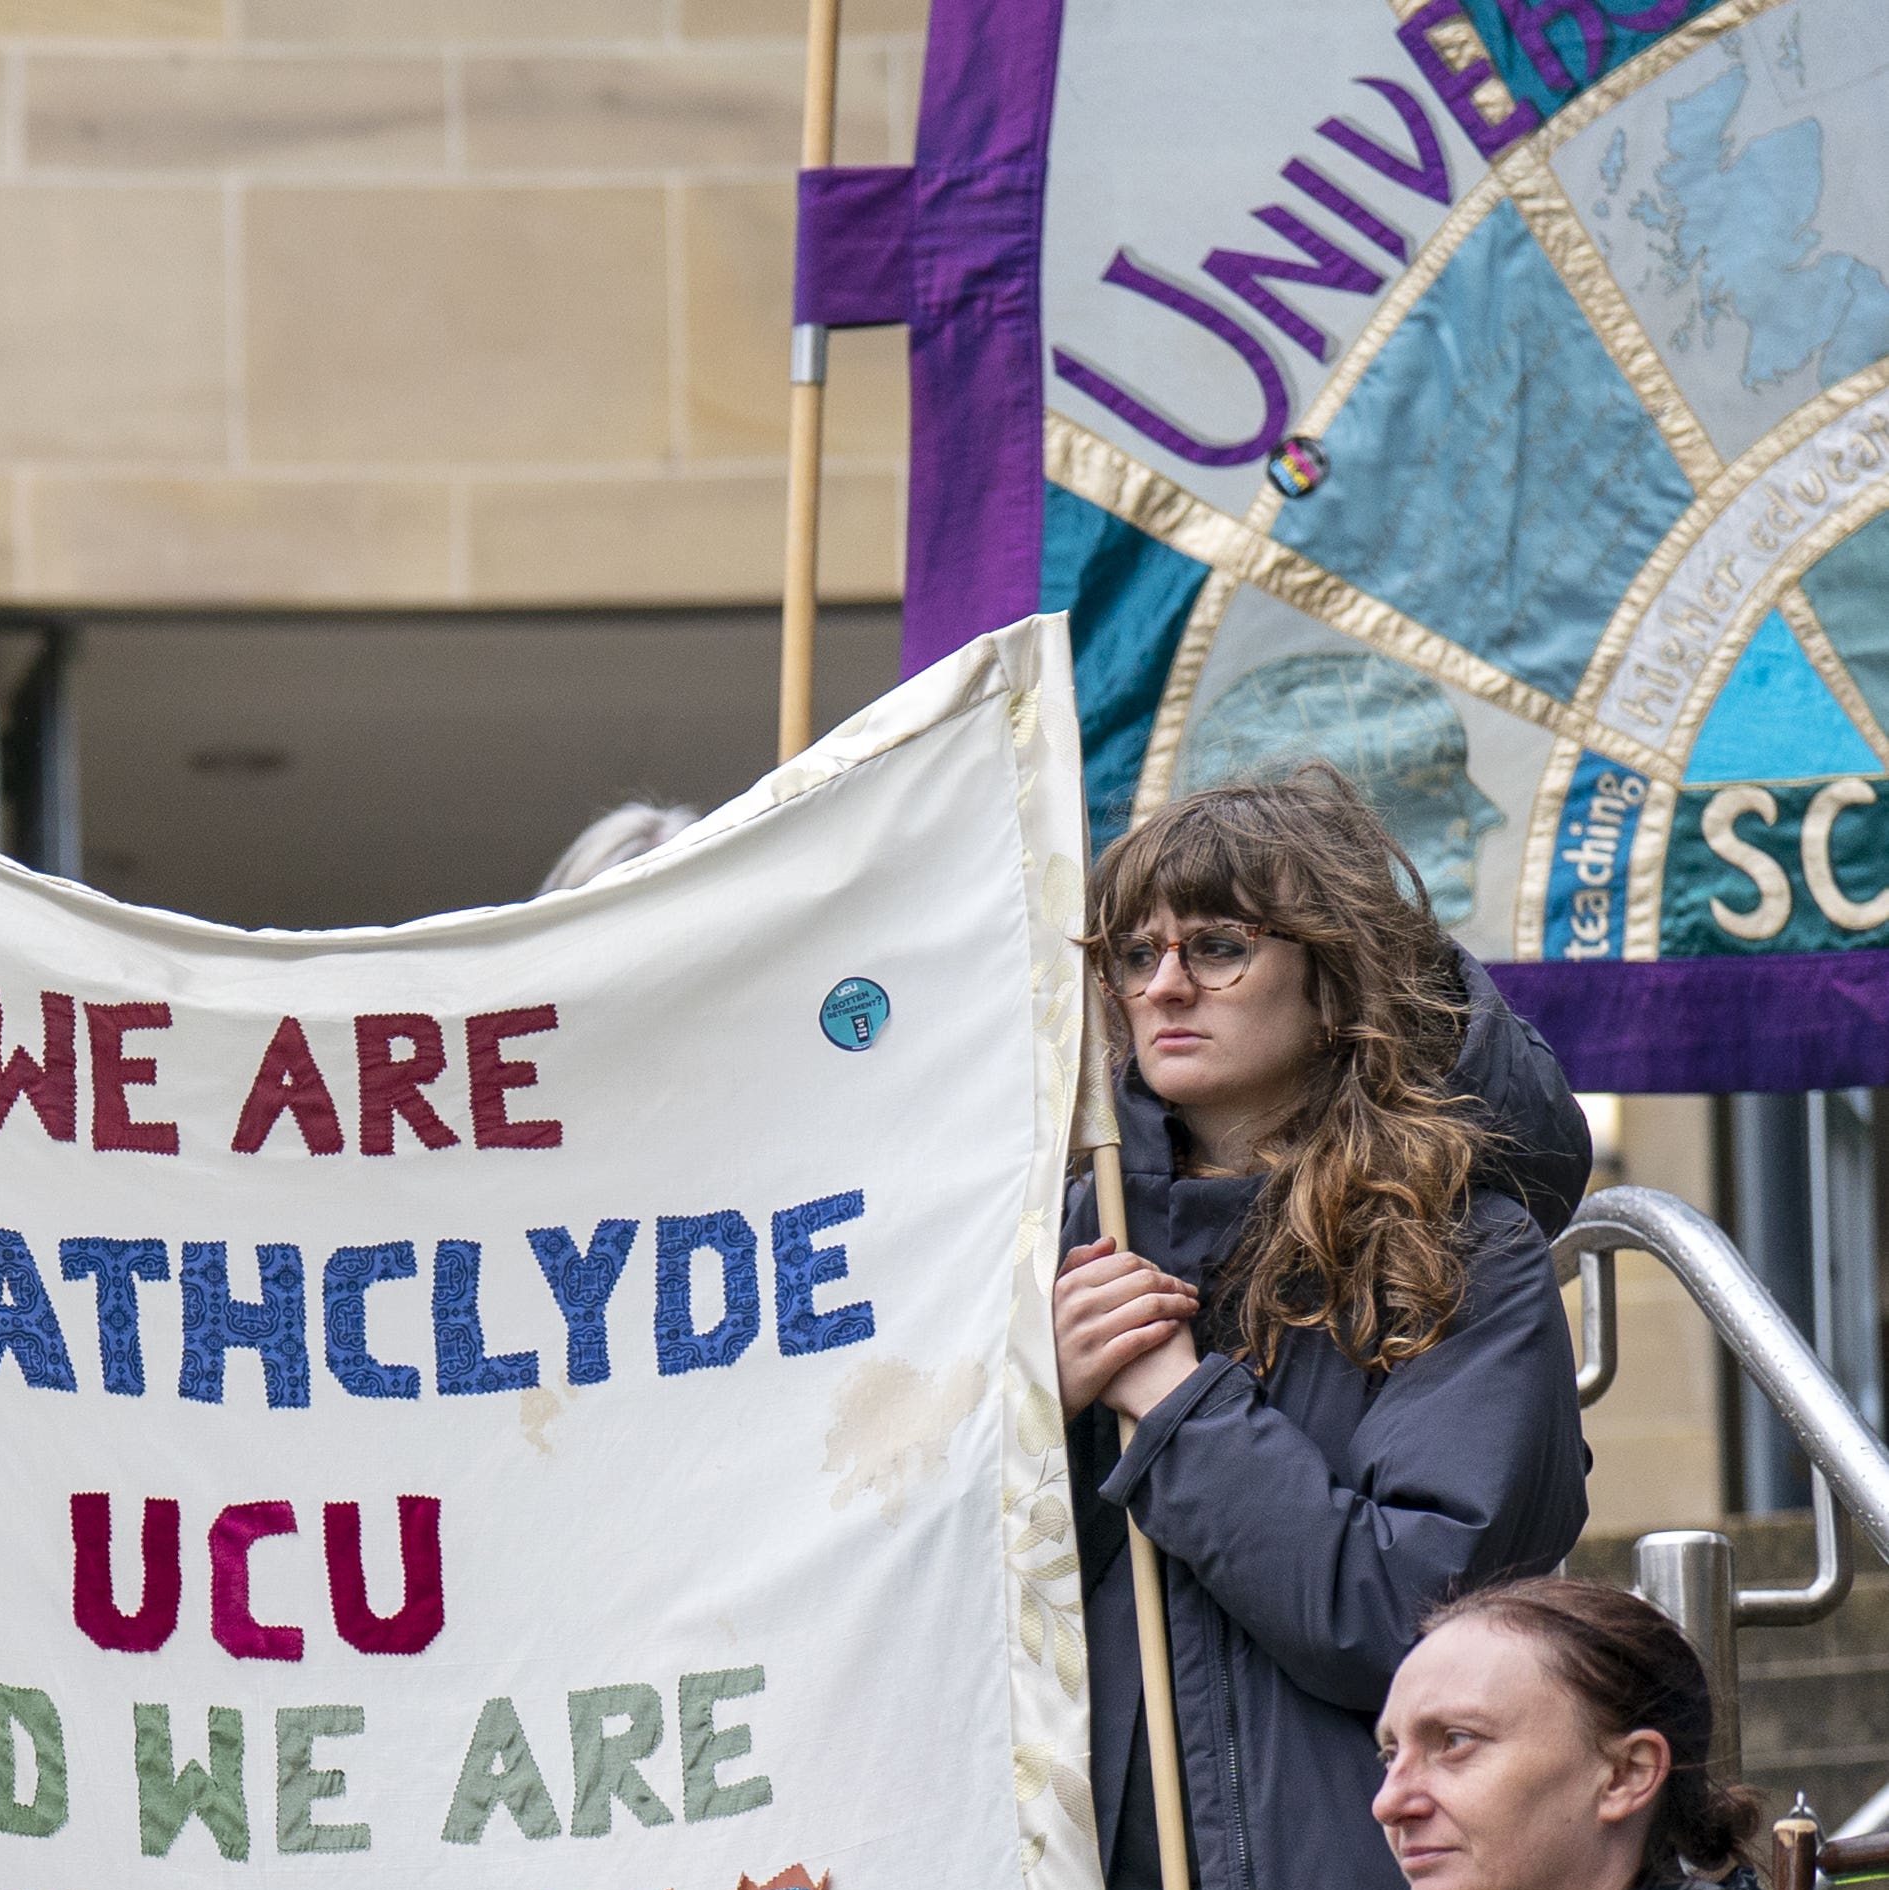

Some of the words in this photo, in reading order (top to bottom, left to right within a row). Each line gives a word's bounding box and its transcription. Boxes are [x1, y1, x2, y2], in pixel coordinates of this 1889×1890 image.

[1748, 412, 1889, 552] educa
[1562, 772, 1646, 961] teaching
[831, 990, 870, 1011] ROTTEN
[835, 983, 858, 997] UCU
[230, 1003, 563, 1157] ARE
[69, 1491, 446, 1662] UCU
[133, 1701, 372, 1864] WE
[439, 1663, 774, 1844] ARE
